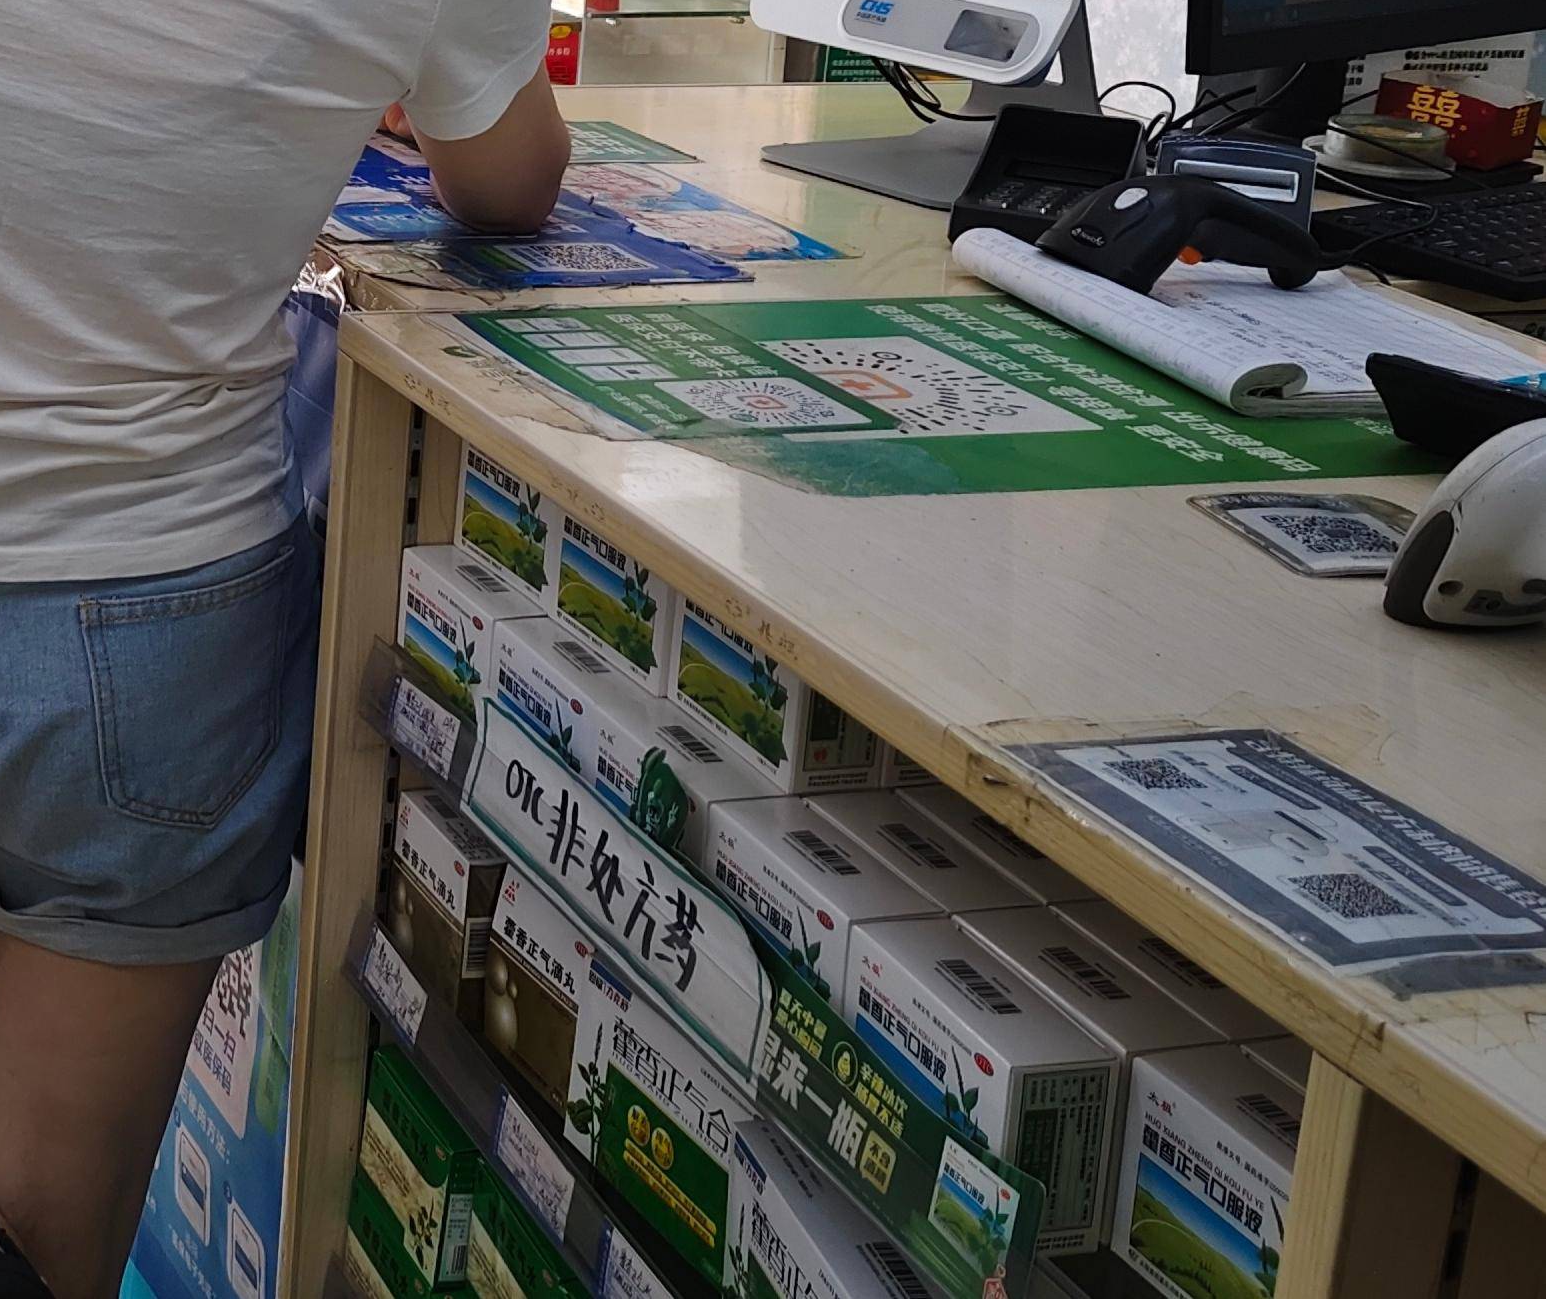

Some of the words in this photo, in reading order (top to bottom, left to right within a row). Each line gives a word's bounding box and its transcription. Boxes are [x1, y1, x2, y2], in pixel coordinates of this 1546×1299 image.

[1125, 424, 1225, 464] 更安全
[1159, 410, 1322, 473] 出示健康码
[504, 916, 576, 995] 藿香正气滴丸
[202, 1005, 238, 1065] 扫一扫
[859, 985, 947, 1085] 藿香正气口服液
[1142, 1123, 1263, 1237] 藿香正气口服液
